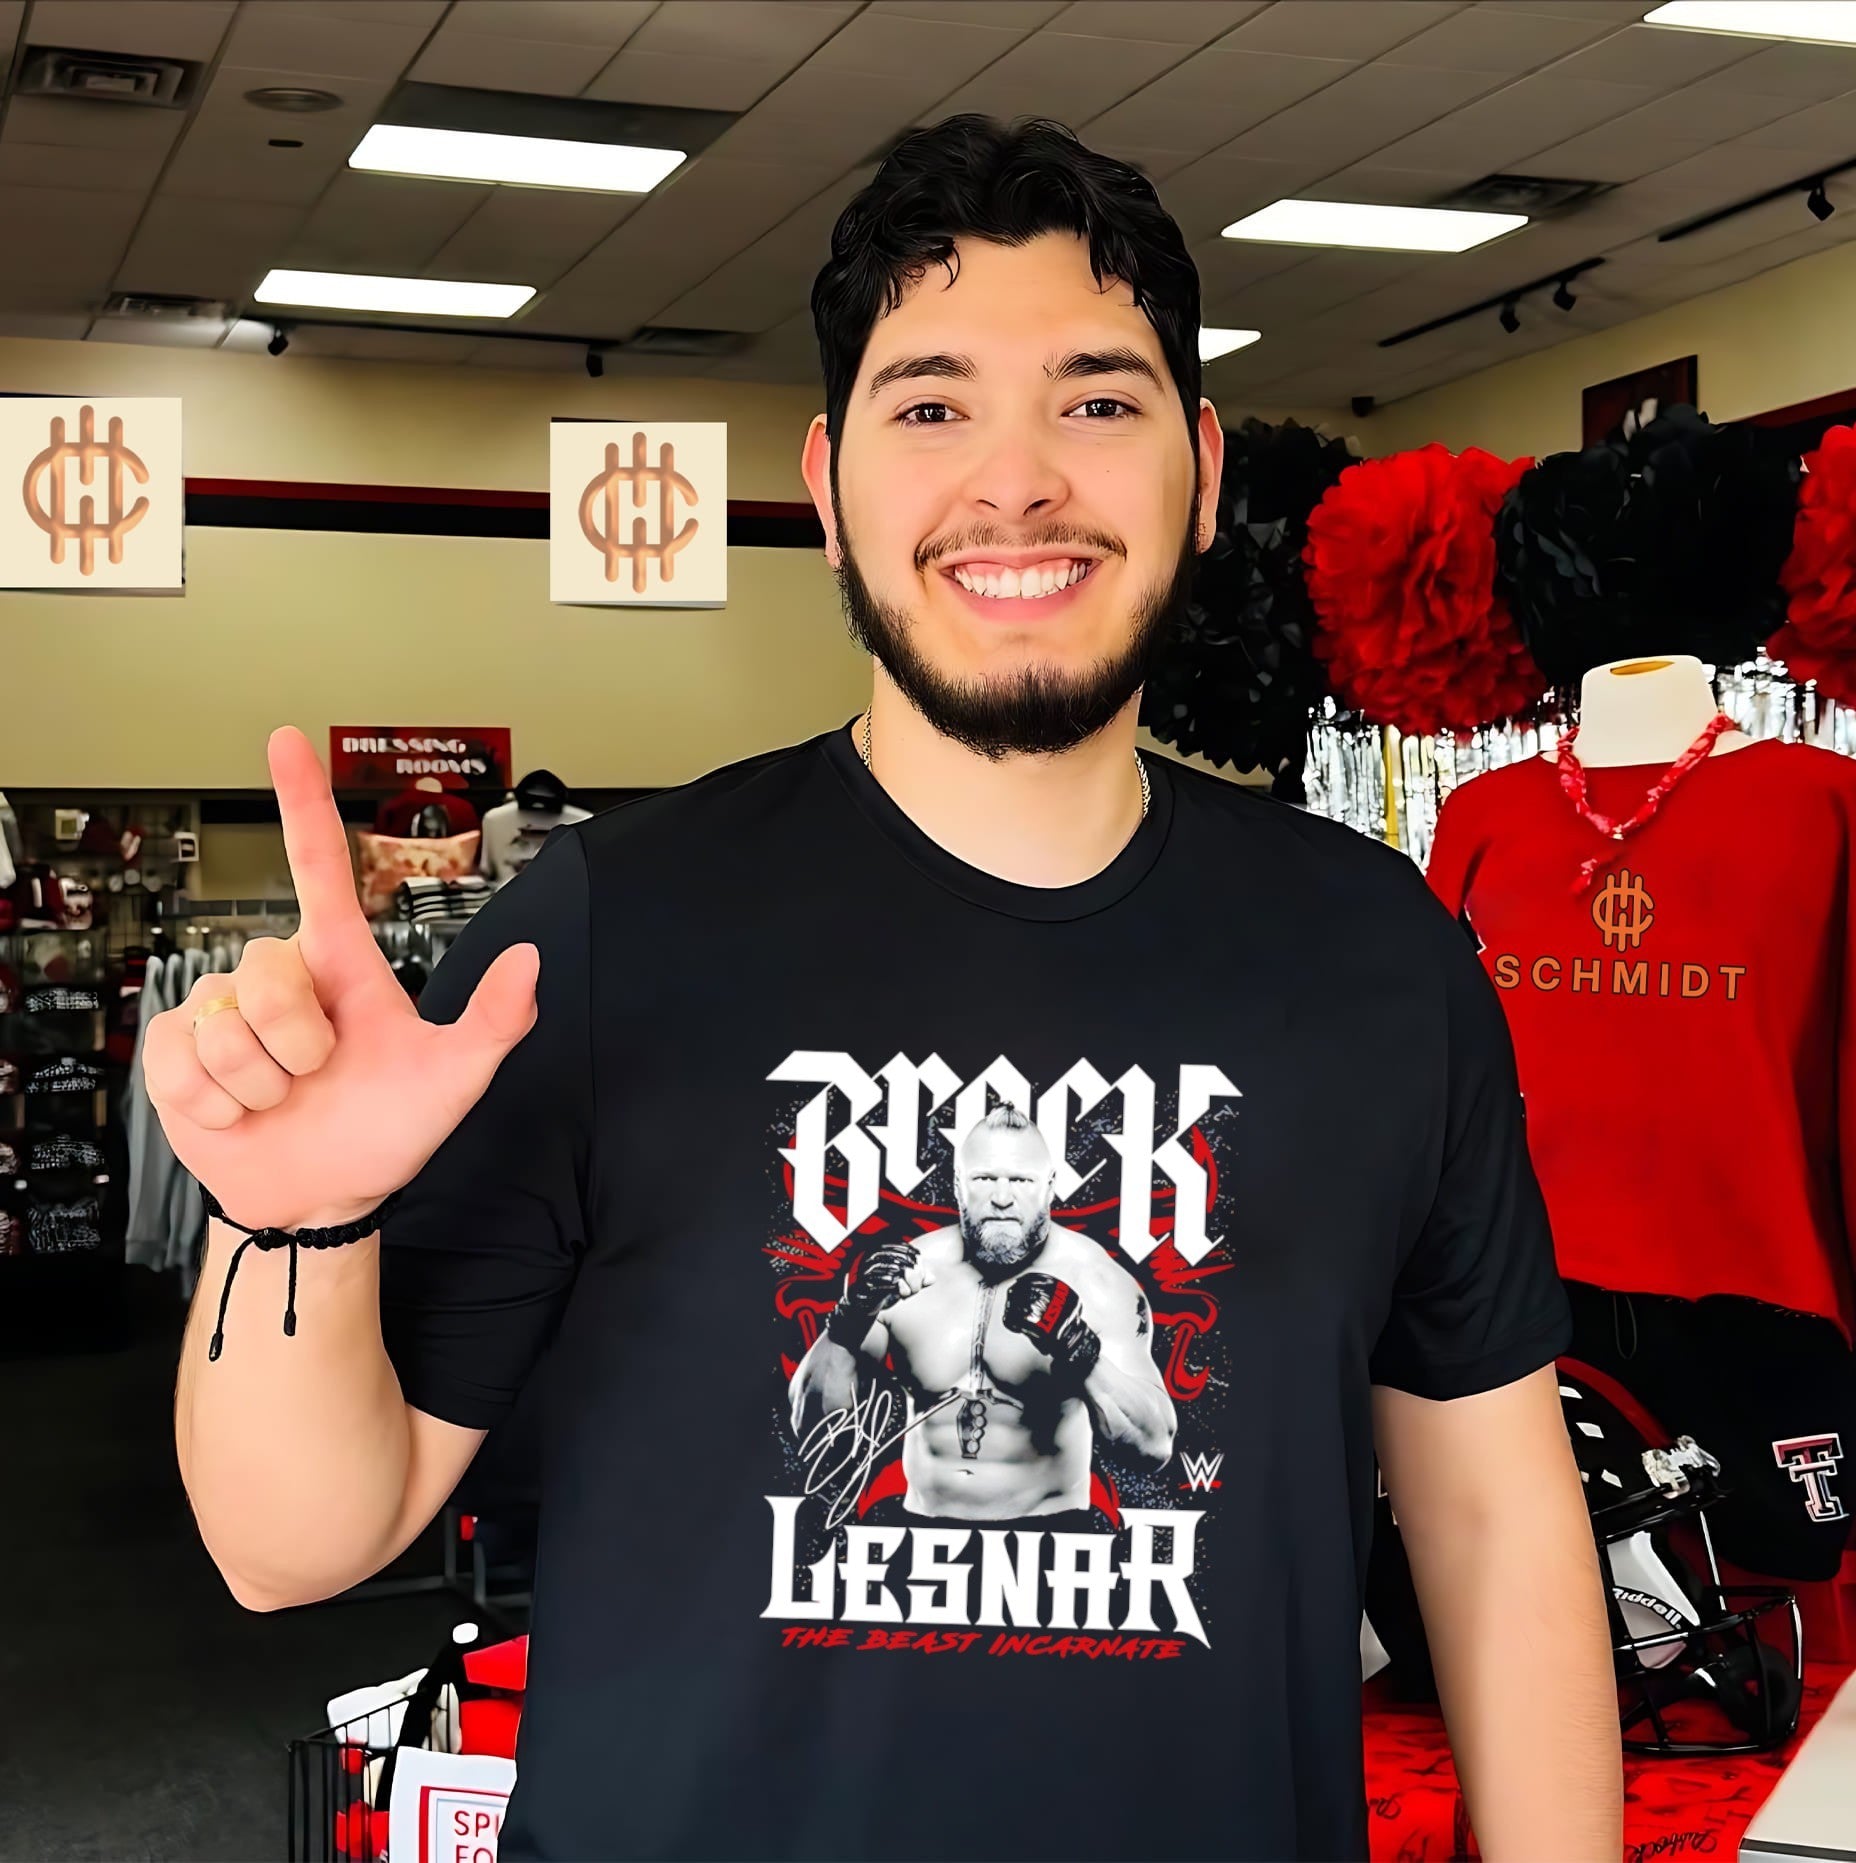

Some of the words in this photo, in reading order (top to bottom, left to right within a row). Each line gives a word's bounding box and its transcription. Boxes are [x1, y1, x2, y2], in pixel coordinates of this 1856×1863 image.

[396, 758, 487, 775] ROOMS
[1494, 954, 1747, 1000] SCHMIDT
[781, 1627, 853, 1648] THE
[857, 1630, 982, 1655] BEAST
[988, 1633, 1187, 1660] INCARNATE
